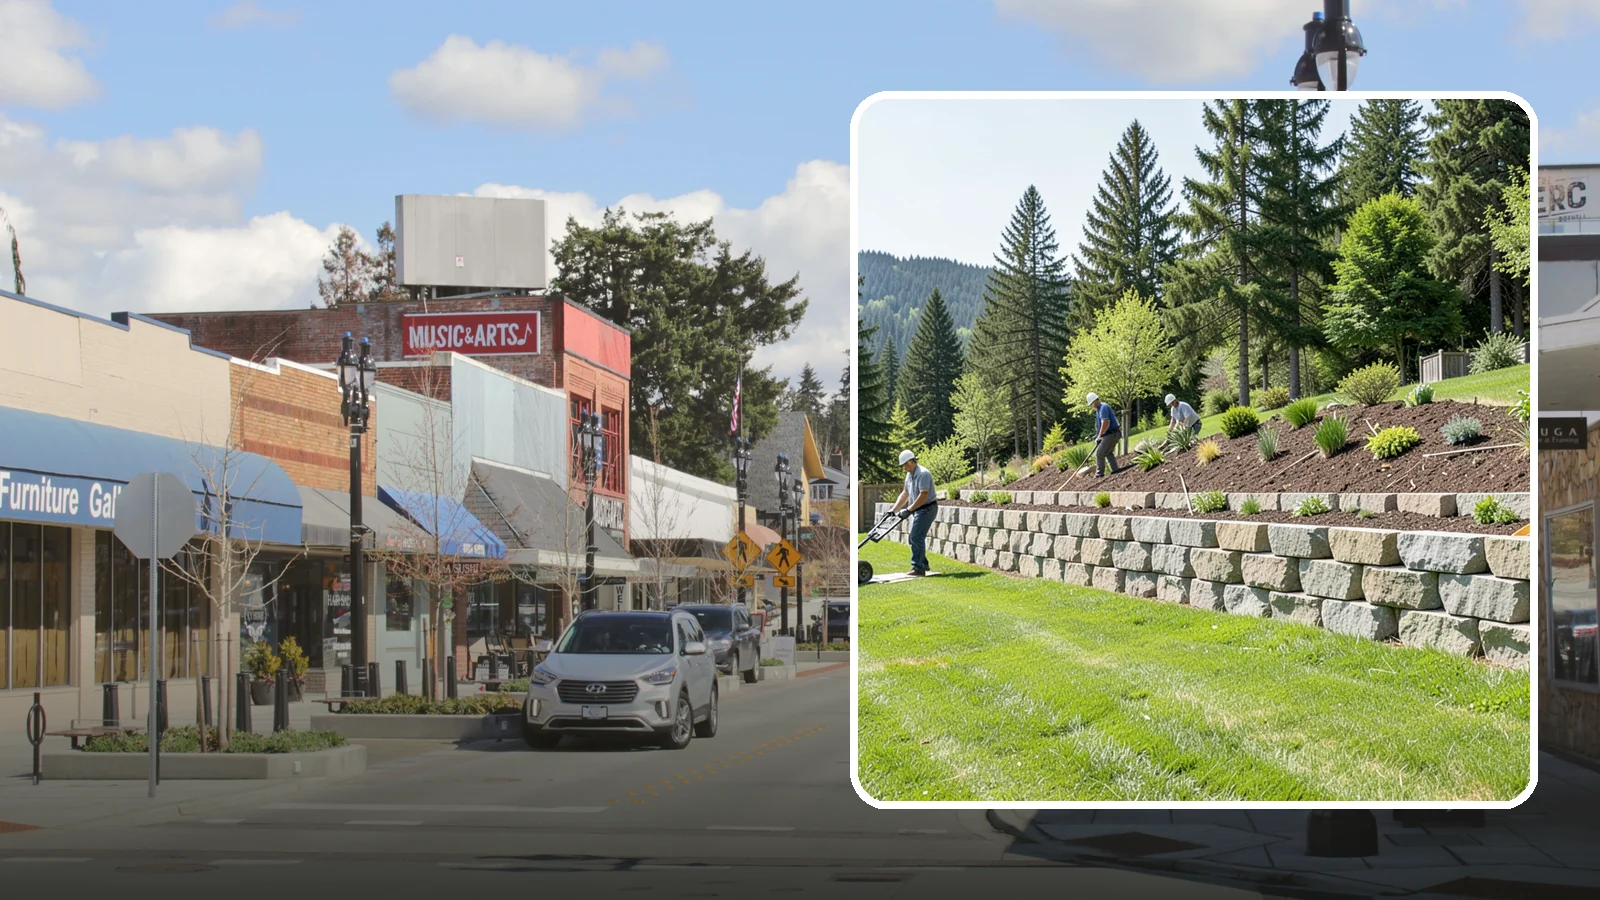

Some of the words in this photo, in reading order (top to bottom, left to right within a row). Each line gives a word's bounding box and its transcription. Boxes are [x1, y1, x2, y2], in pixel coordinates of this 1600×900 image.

[1540, 427, 1578, 437] UGA
[0, 471, 79, 515] Furniture
[90, 482, 122, 519] Gal
[453, 563, 479, 574] SUSHI
